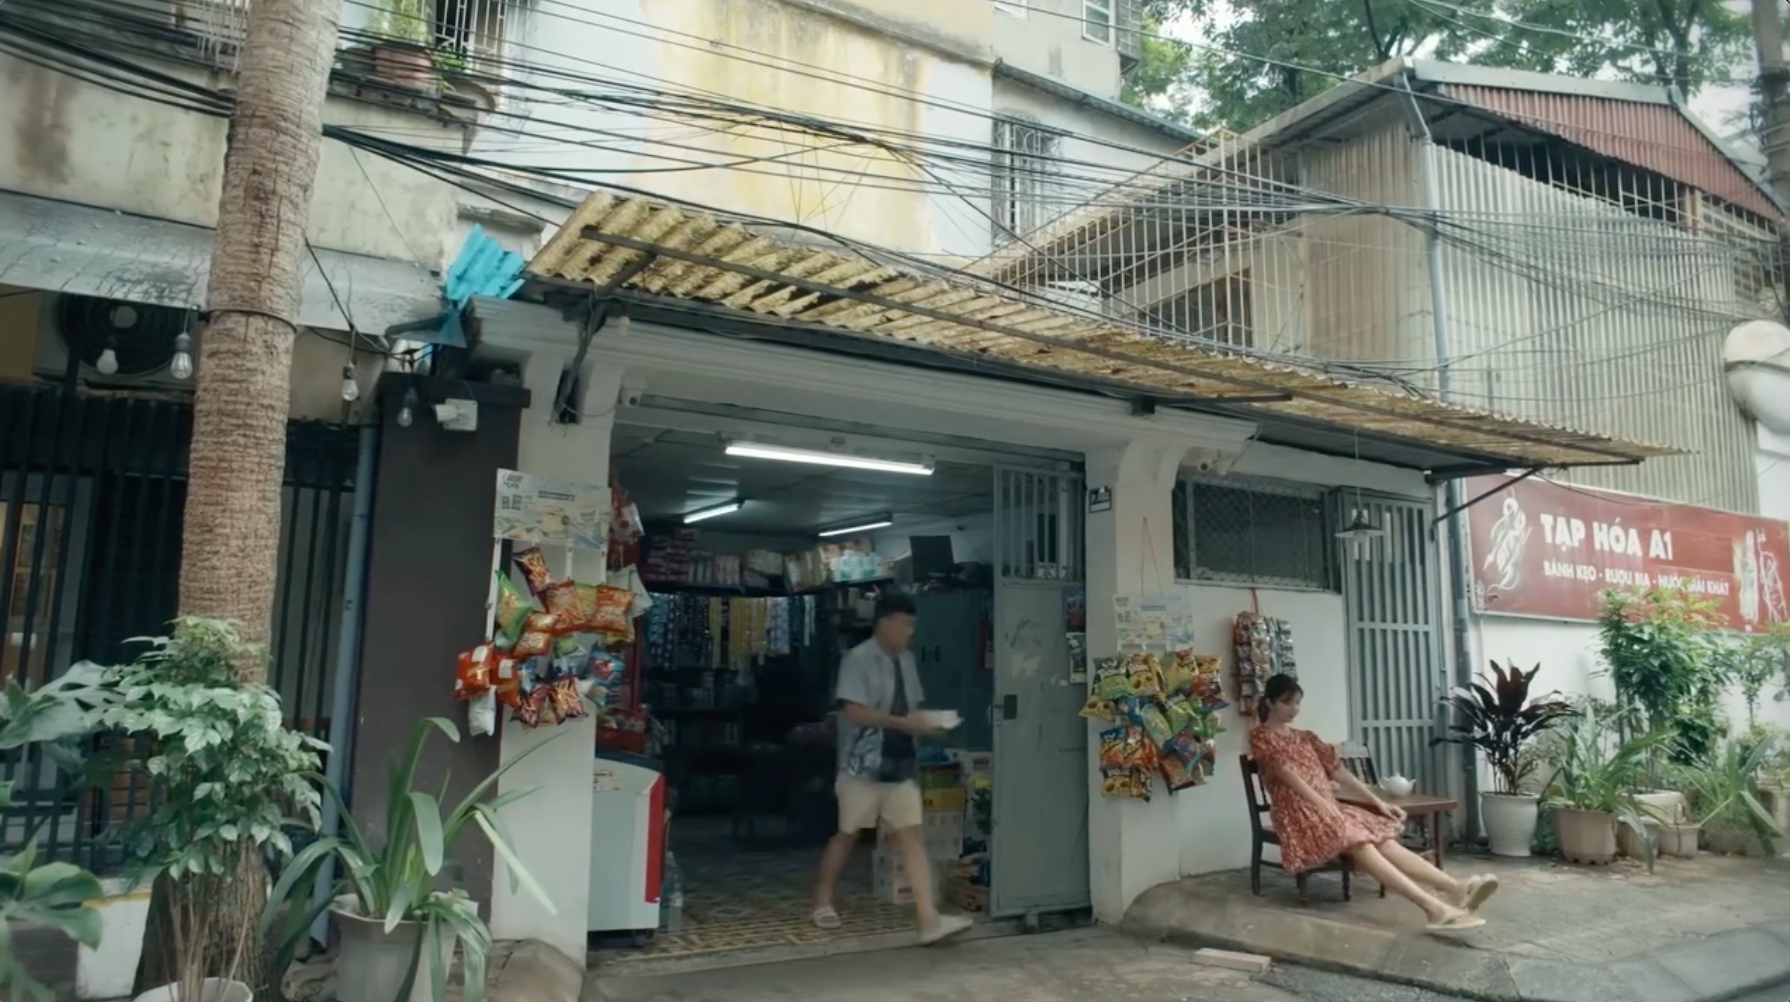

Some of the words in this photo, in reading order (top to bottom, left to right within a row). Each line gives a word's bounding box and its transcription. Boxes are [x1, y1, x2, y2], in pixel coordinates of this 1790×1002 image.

[1540, 513, 1586, 552] TẠP
[1593, 517, 1642, 557] HÓA
[1649, 529, 1673, 560] A1
[1543, 557, 1574, 578] BÁNH
[1576, 564, 1597, 583] KẸO
